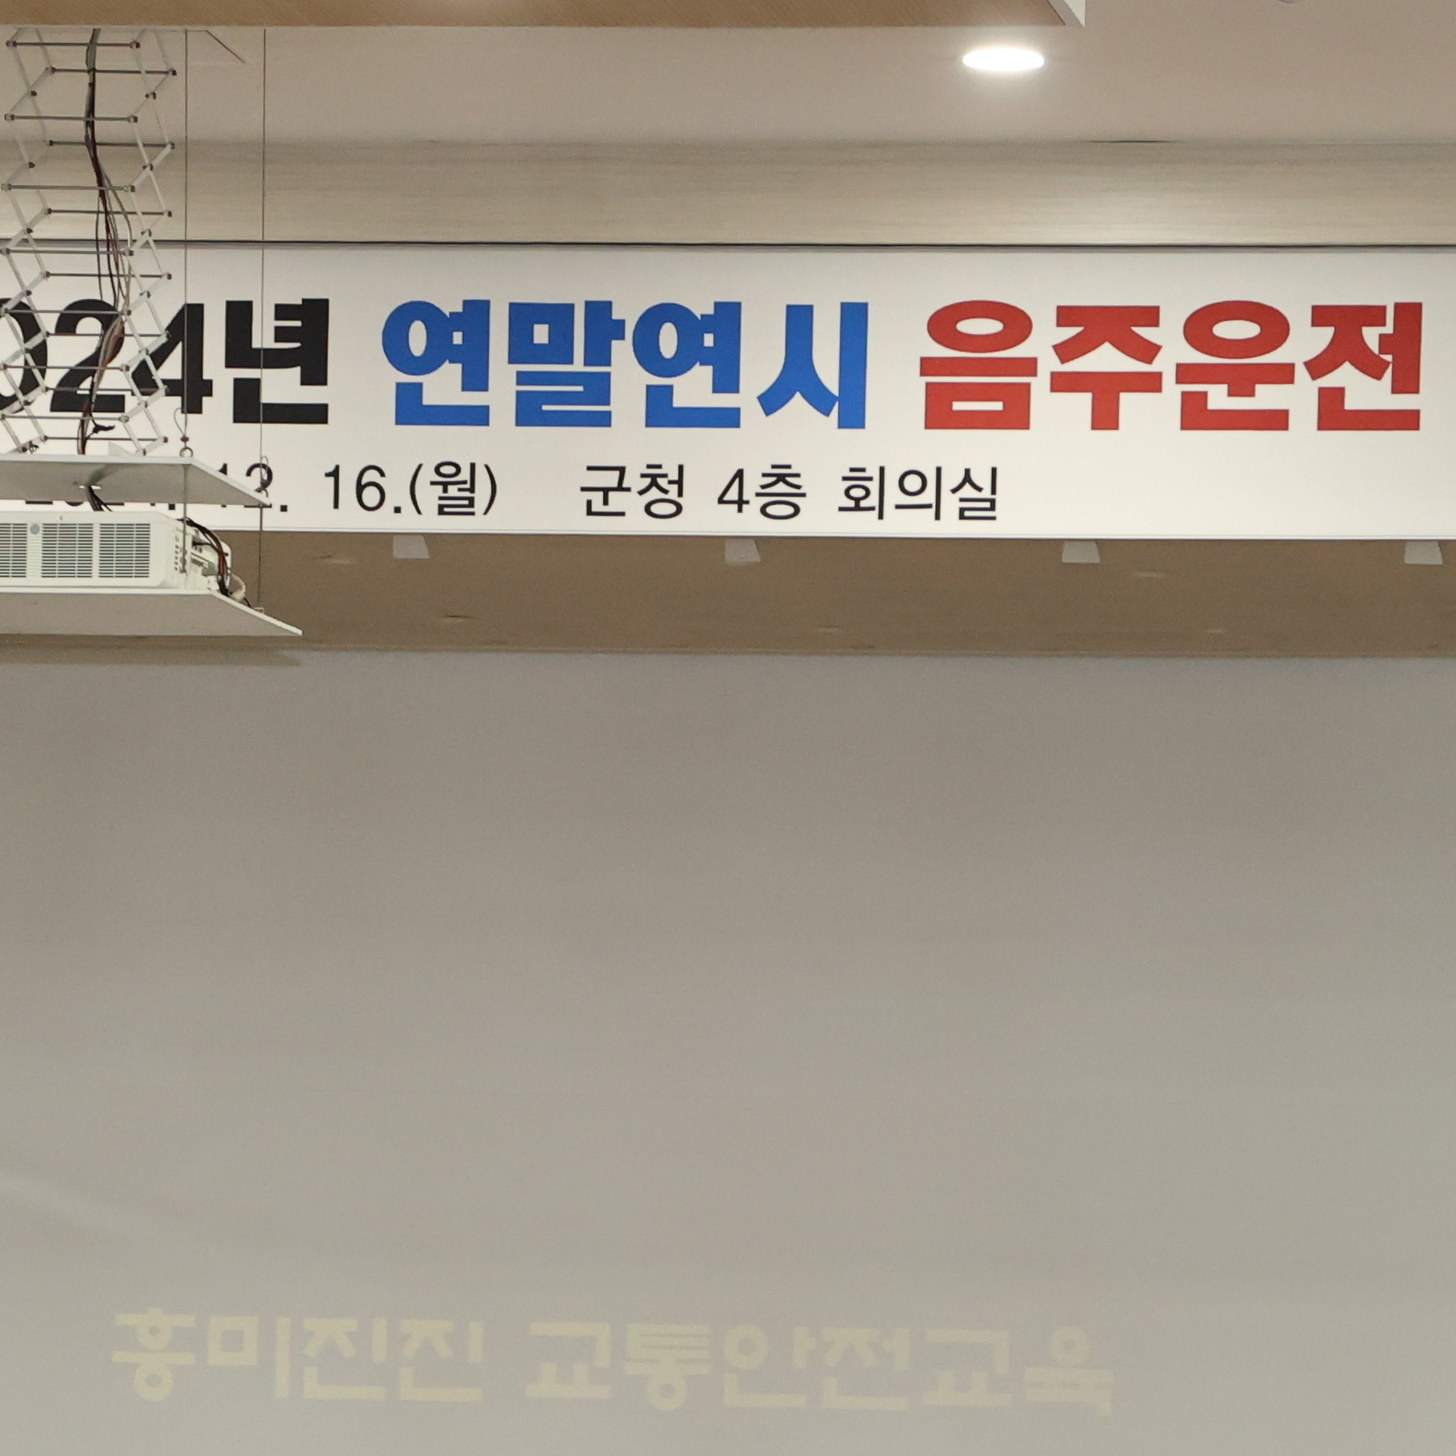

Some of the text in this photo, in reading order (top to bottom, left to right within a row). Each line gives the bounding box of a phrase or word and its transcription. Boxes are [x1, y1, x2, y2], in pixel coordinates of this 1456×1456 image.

[381, 298, 869, 429] 연말연시
[919, 300, 1423, 432] 음주운전
[324, 461, 497, 517] 16.(월)
[579, 463, 685, 520] 군청
[717, 464, 807, 521] 4층
[838, 465, 999, 521] 회의실
[111, 1306, 1116, 1417] 흥미진진 교통안전교육
